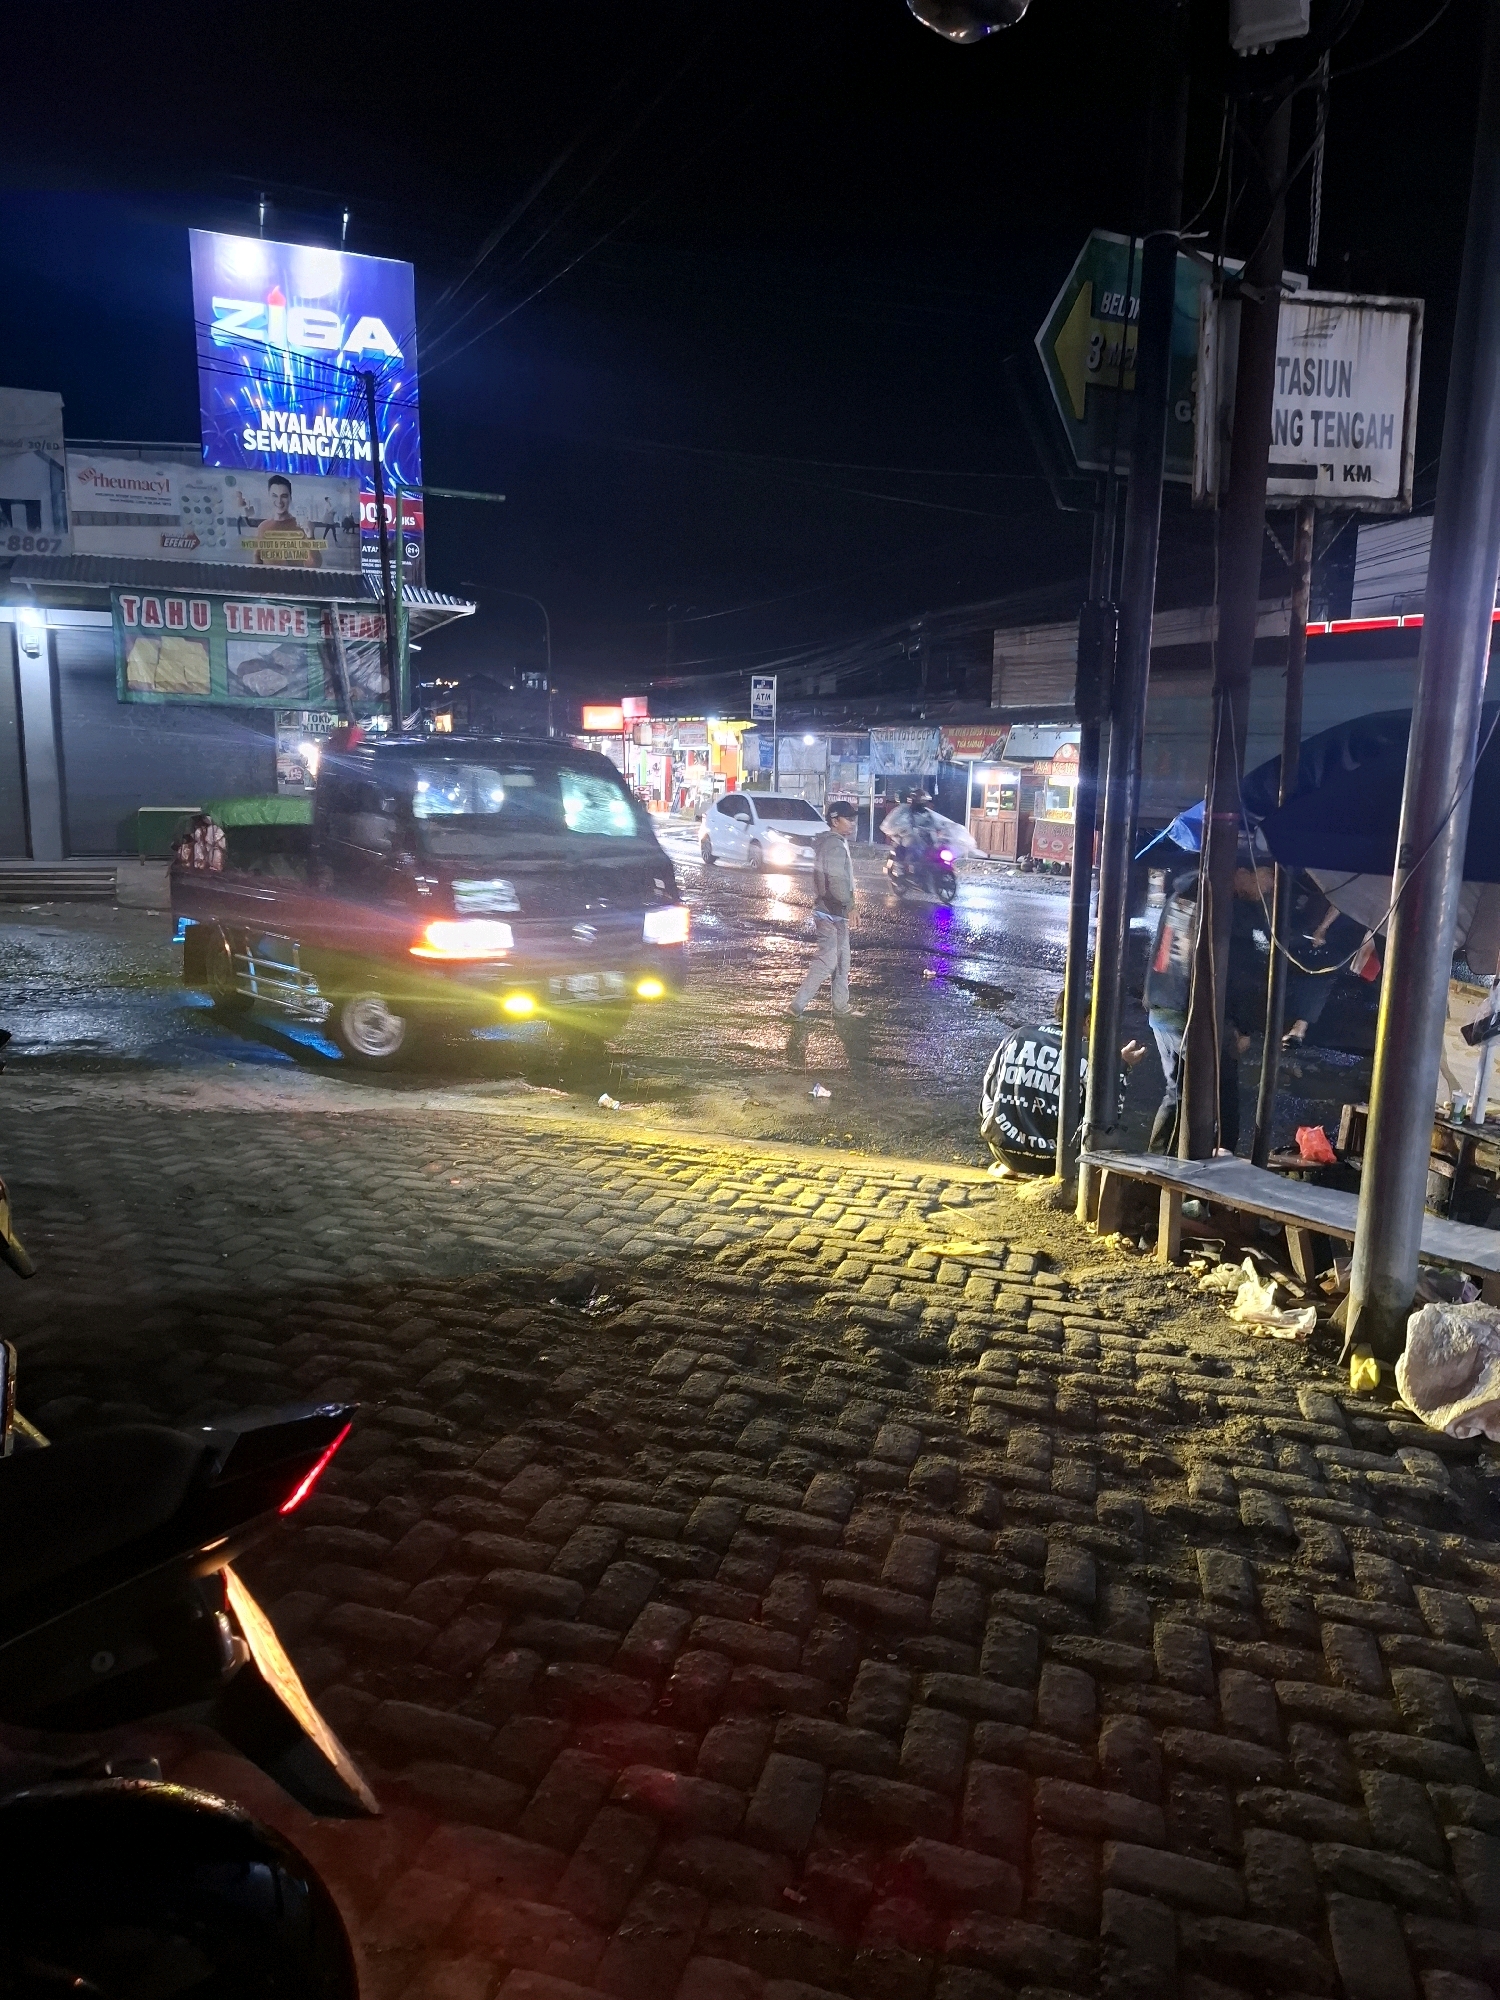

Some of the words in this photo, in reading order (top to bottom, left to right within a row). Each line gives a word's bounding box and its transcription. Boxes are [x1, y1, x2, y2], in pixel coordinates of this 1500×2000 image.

[1277, 356, 1352, 398] TASIUN
[260, 410, 367, 441] NYALAKAN
[1310, 410, 1395, 449] TENGAH
[94, 473, 171, 496] rheumacyl
[1343, 464, 1372, 482] KM
[163, 537, 198, 549] EFEKTIF
[120, 595, 211, 631] TAHU
[224, 602, 309, 637] TEMPE
[756, 693, 771, 701] ATM
[994, 1112, 1027, 1145] BORN
[1028, 1135, 1047, 1149] TO
